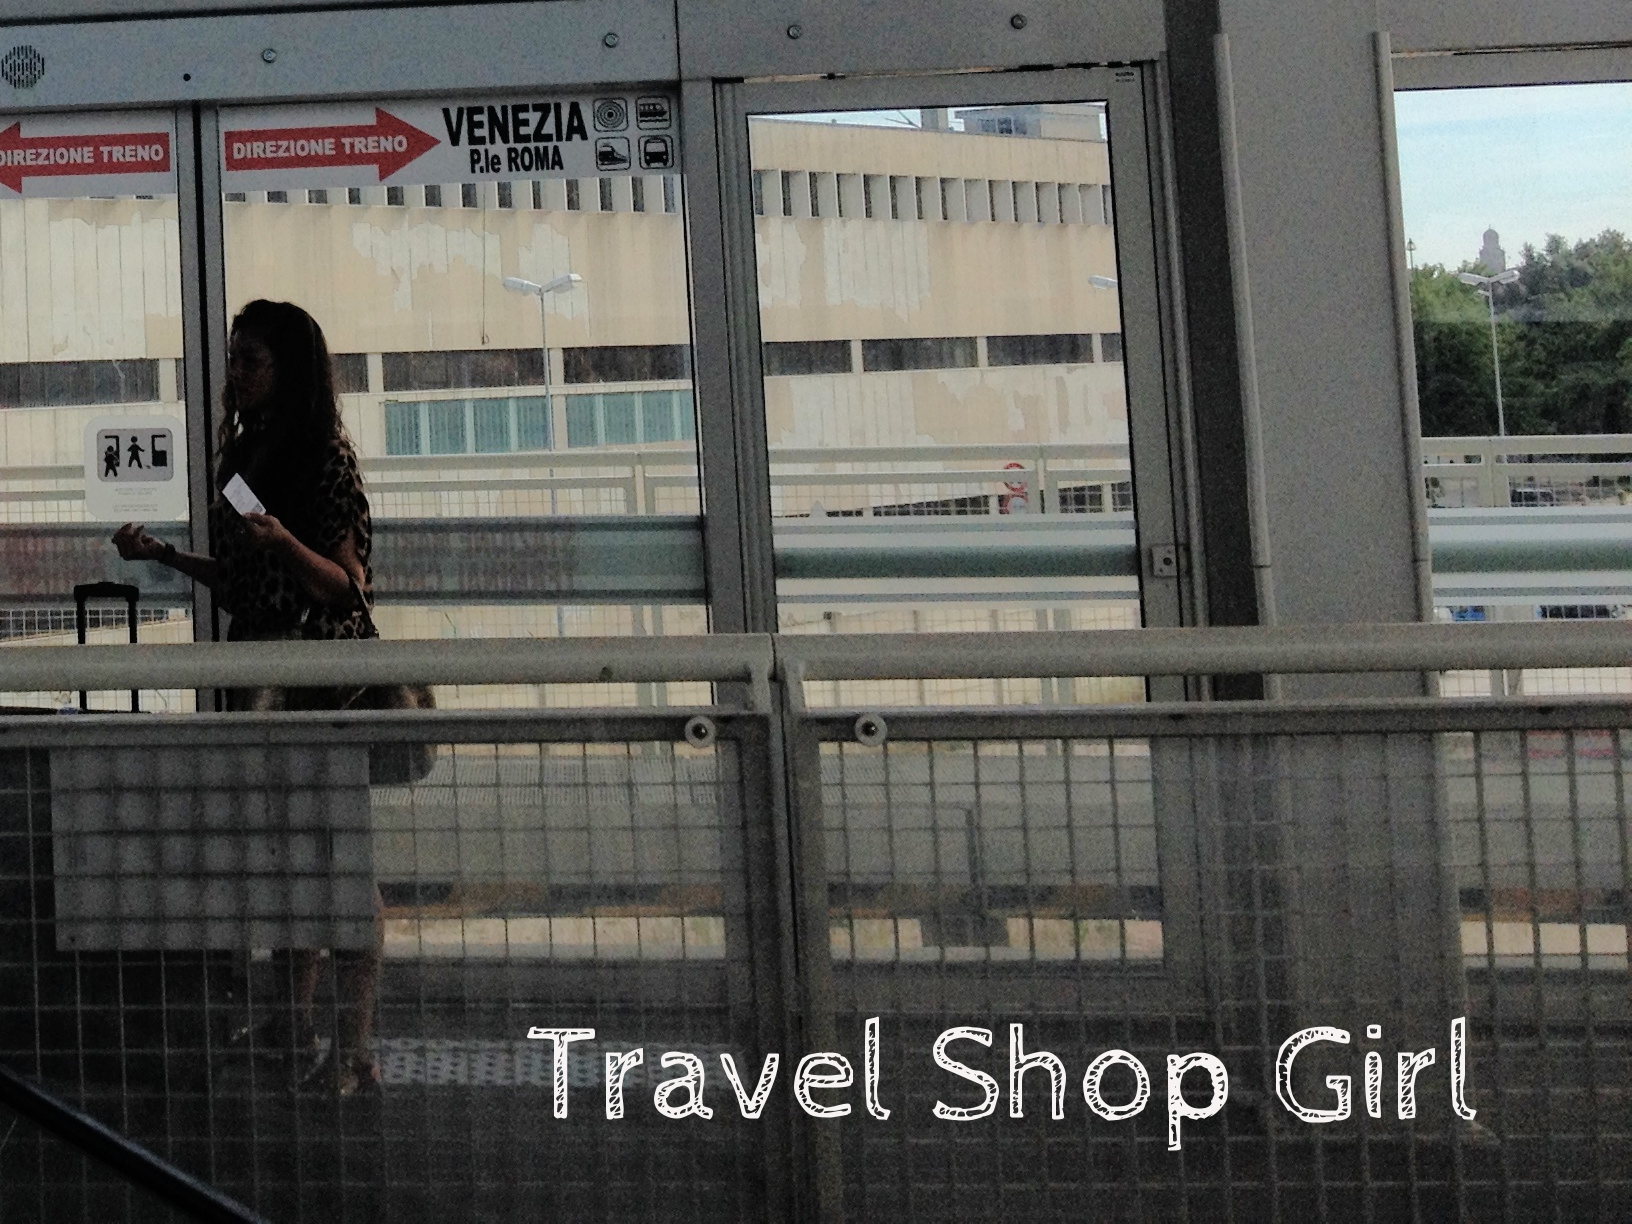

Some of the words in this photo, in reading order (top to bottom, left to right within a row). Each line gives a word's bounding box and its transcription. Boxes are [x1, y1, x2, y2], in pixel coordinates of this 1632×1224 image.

[442, 101, 588, 146] VENEZIA
[99, 145, 164, 163] TRENO
[232, 140, 336, 159] DIREZIONE
[342, 135, 408, 154] TRENO
[469, 148, 501, 173] P.le
[507, 146, 564, 172] ROMA
